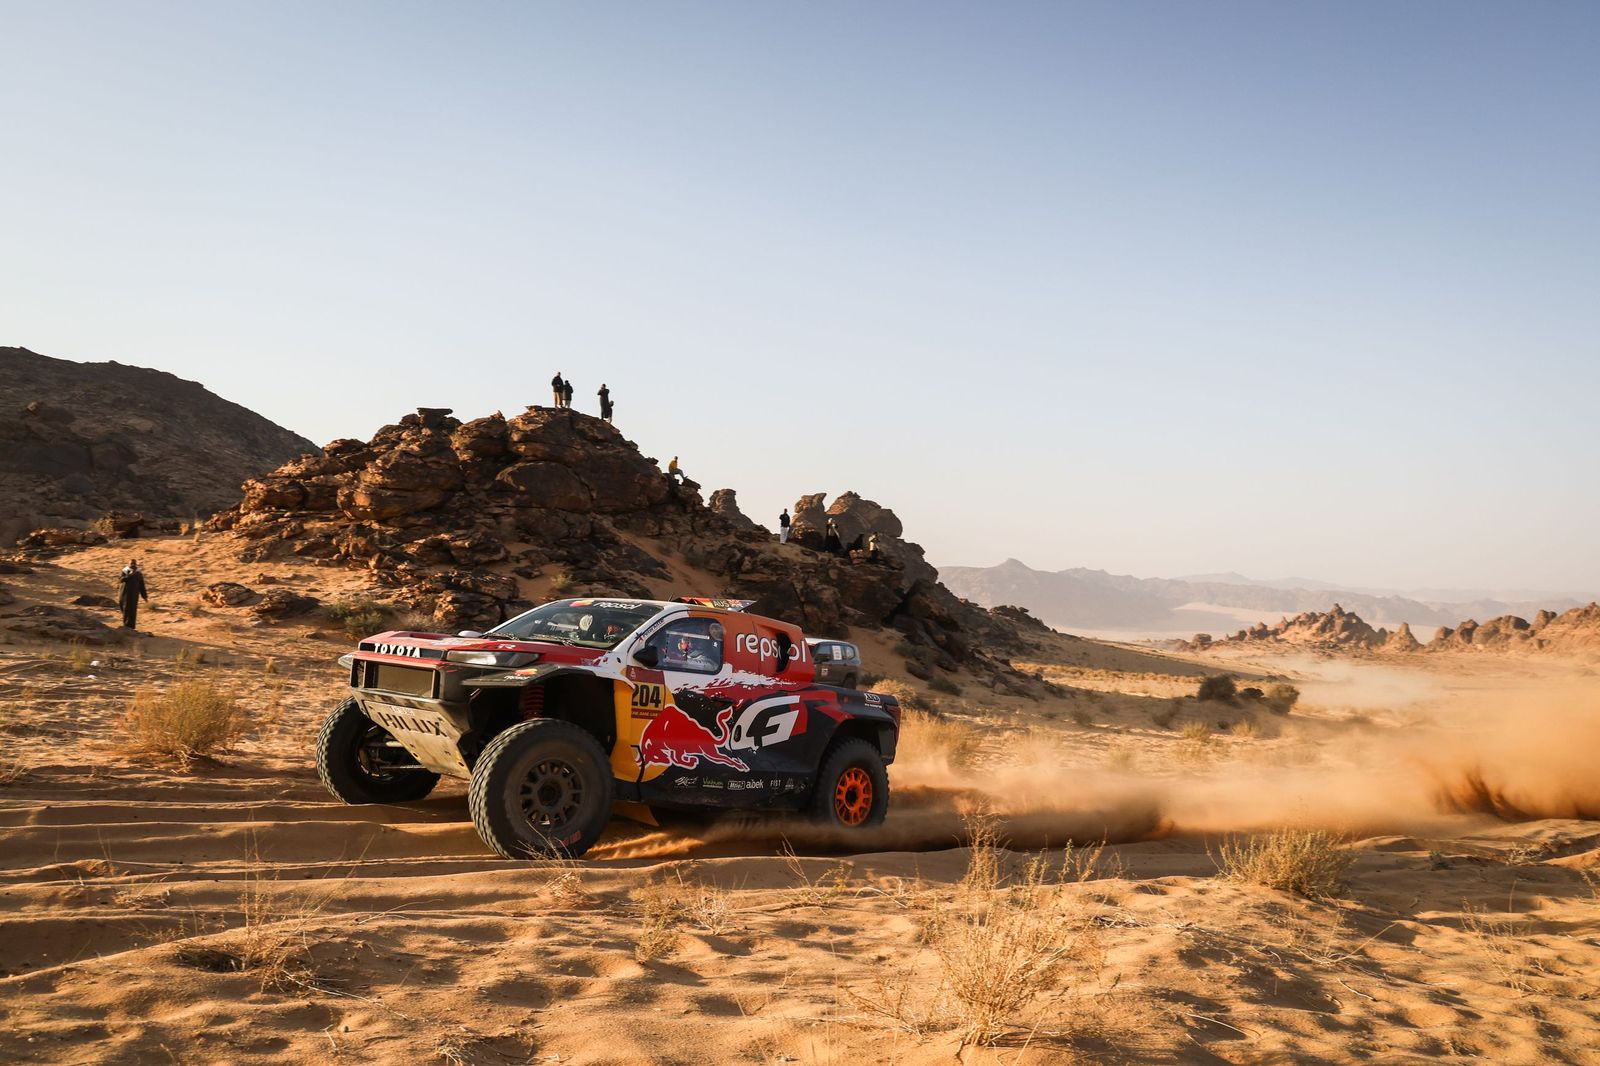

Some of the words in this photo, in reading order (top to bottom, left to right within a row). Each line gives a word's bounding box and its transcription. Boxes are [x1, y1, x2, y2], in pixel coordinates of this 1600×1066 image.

[713, 600, 730, 608] AUS
[374, 643, 421, 658] TOYOTA
[736, 633, 806, 663] repsol
[632, 684, 662, 708] 204
[377, 711, 448, 738] HILUX
